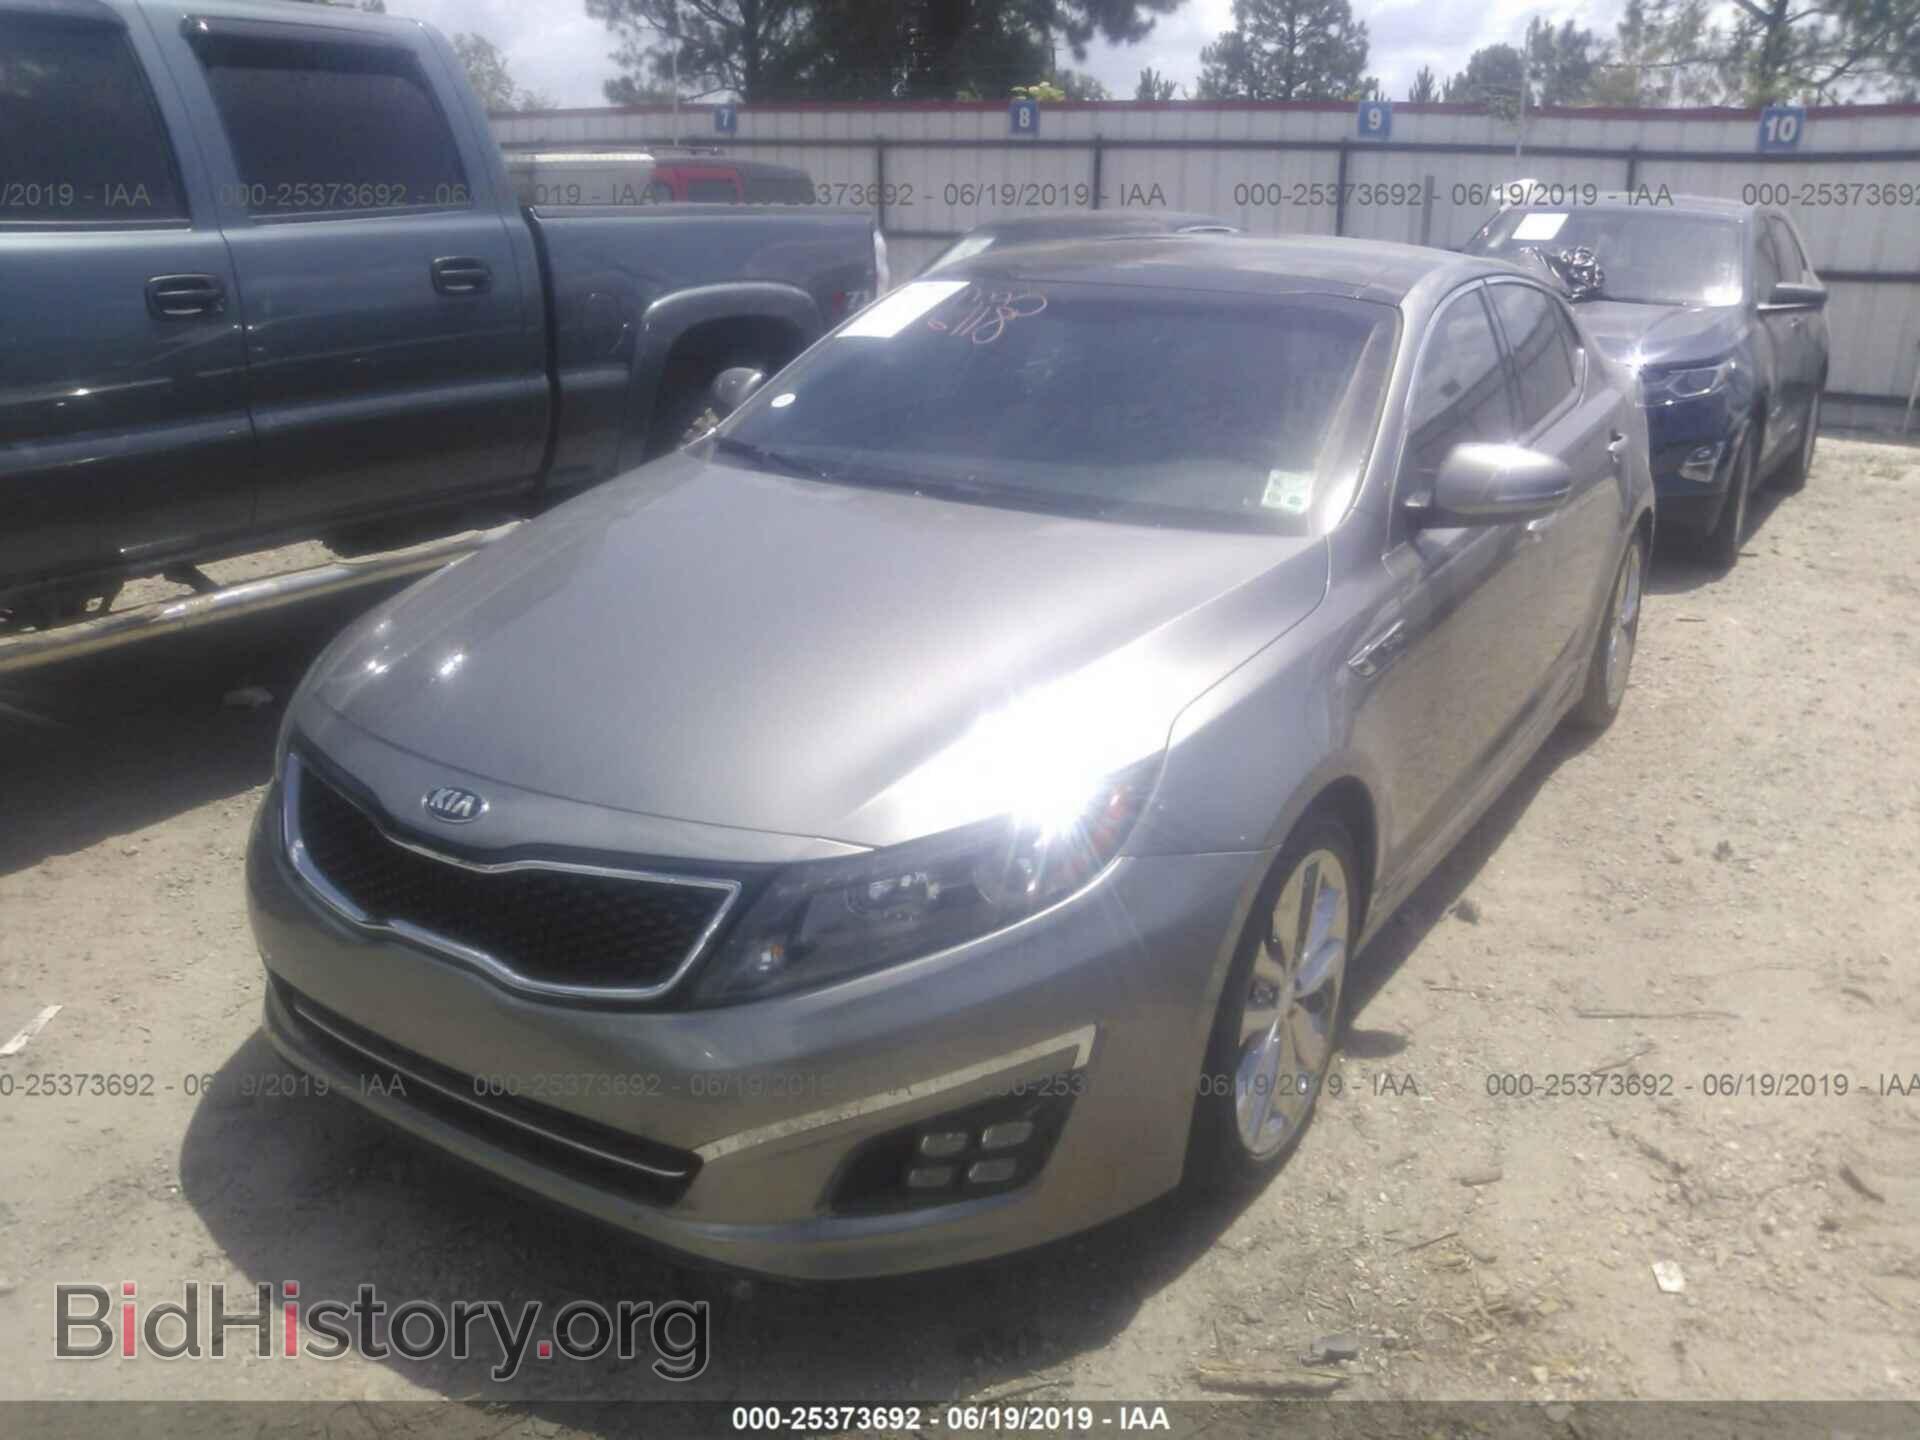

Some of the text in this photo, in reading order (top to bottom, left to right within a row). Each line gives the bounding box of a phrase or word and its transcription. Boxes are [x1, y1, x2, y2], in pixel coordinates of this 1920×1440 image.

[719, 109, 729, 127] 7
[1018, 106, 1031, 129] 8
[1367, 108, 1383, 130] 9
[1765, 115, 1797, 142] 10
[430, 788, 475, 817] KIA
